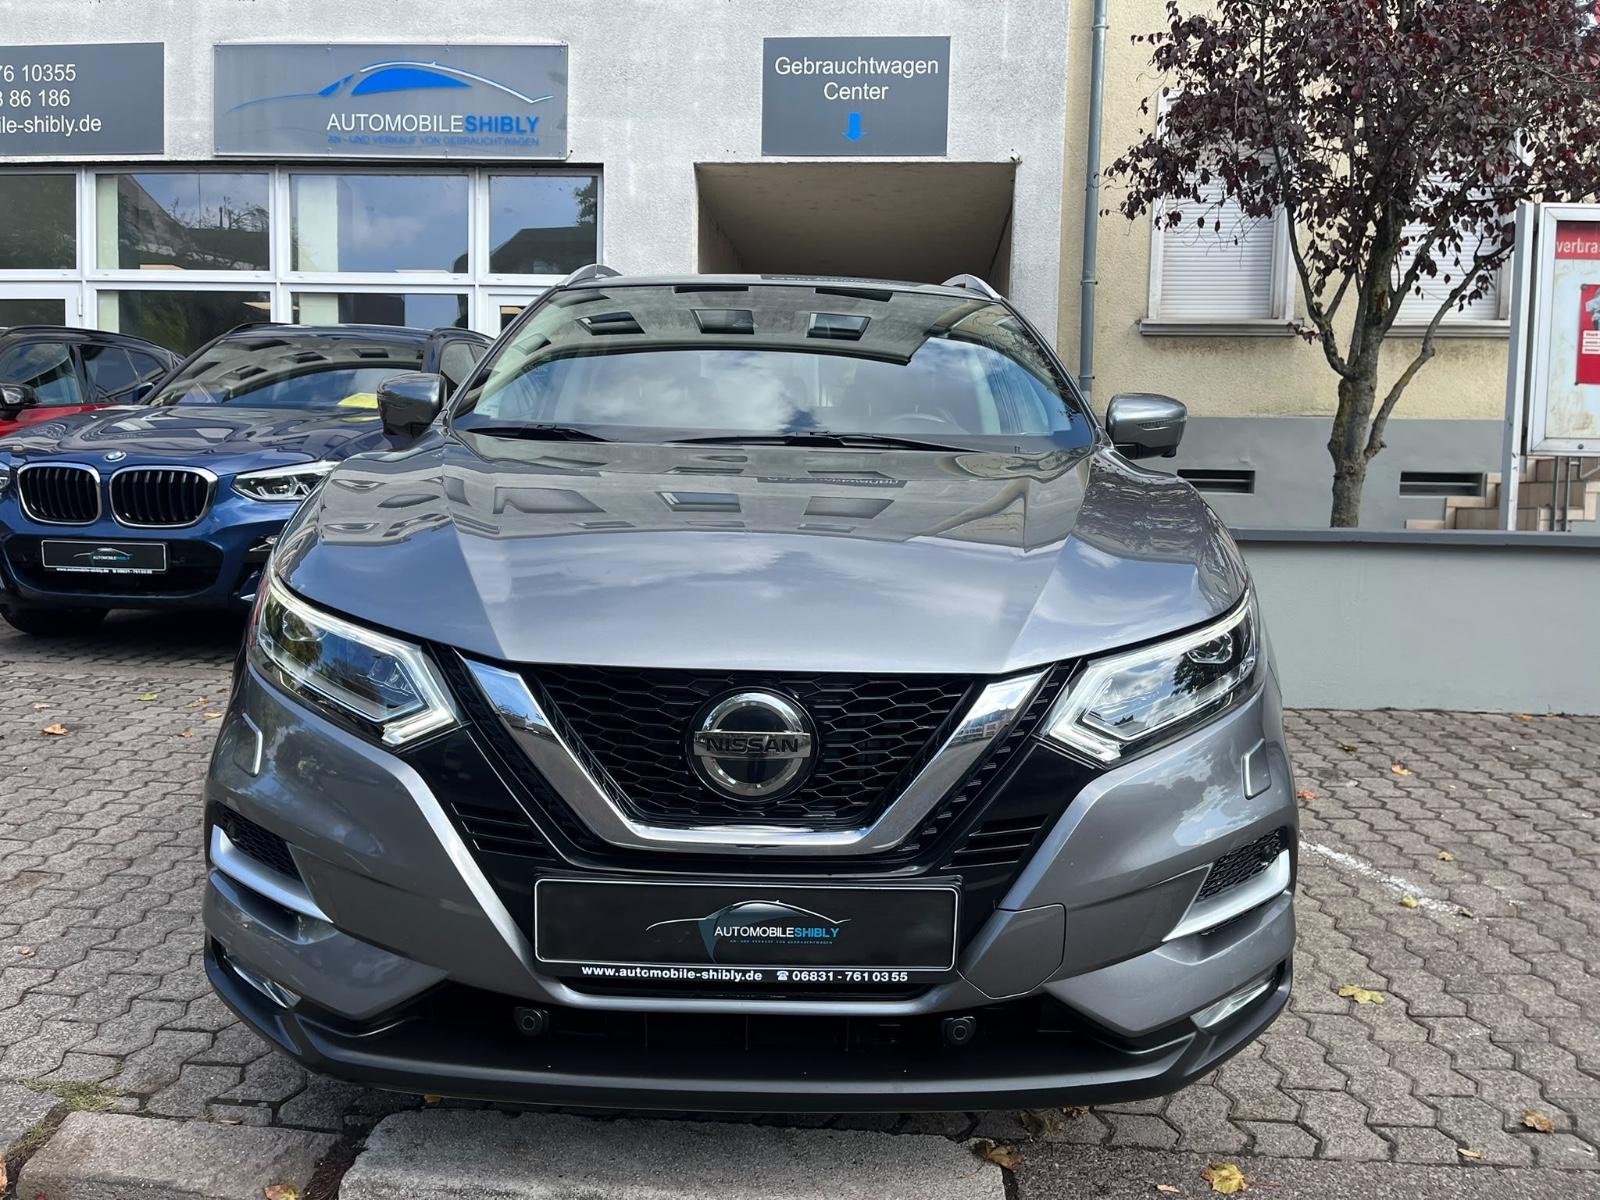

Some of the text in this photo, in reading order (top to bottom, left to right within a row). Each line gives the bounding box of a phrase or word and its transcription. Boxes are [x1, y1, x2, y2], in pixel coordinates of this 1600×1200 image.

[0, 63, 76, 82] 6 10355
[774, 56, 939, 79] Gebrauchtwagen
[9, 89, 31, 107] 86
[38, 89, 71, 107] 186
[823, 82, 889, 100] Center
[1556, 238, 1600, 254] verbra
[706, 737, 799, 754] NISSAN
[581, 966, 763, 982] www.automobile-shibly.de
[792, 970, 834, 982] 06831
